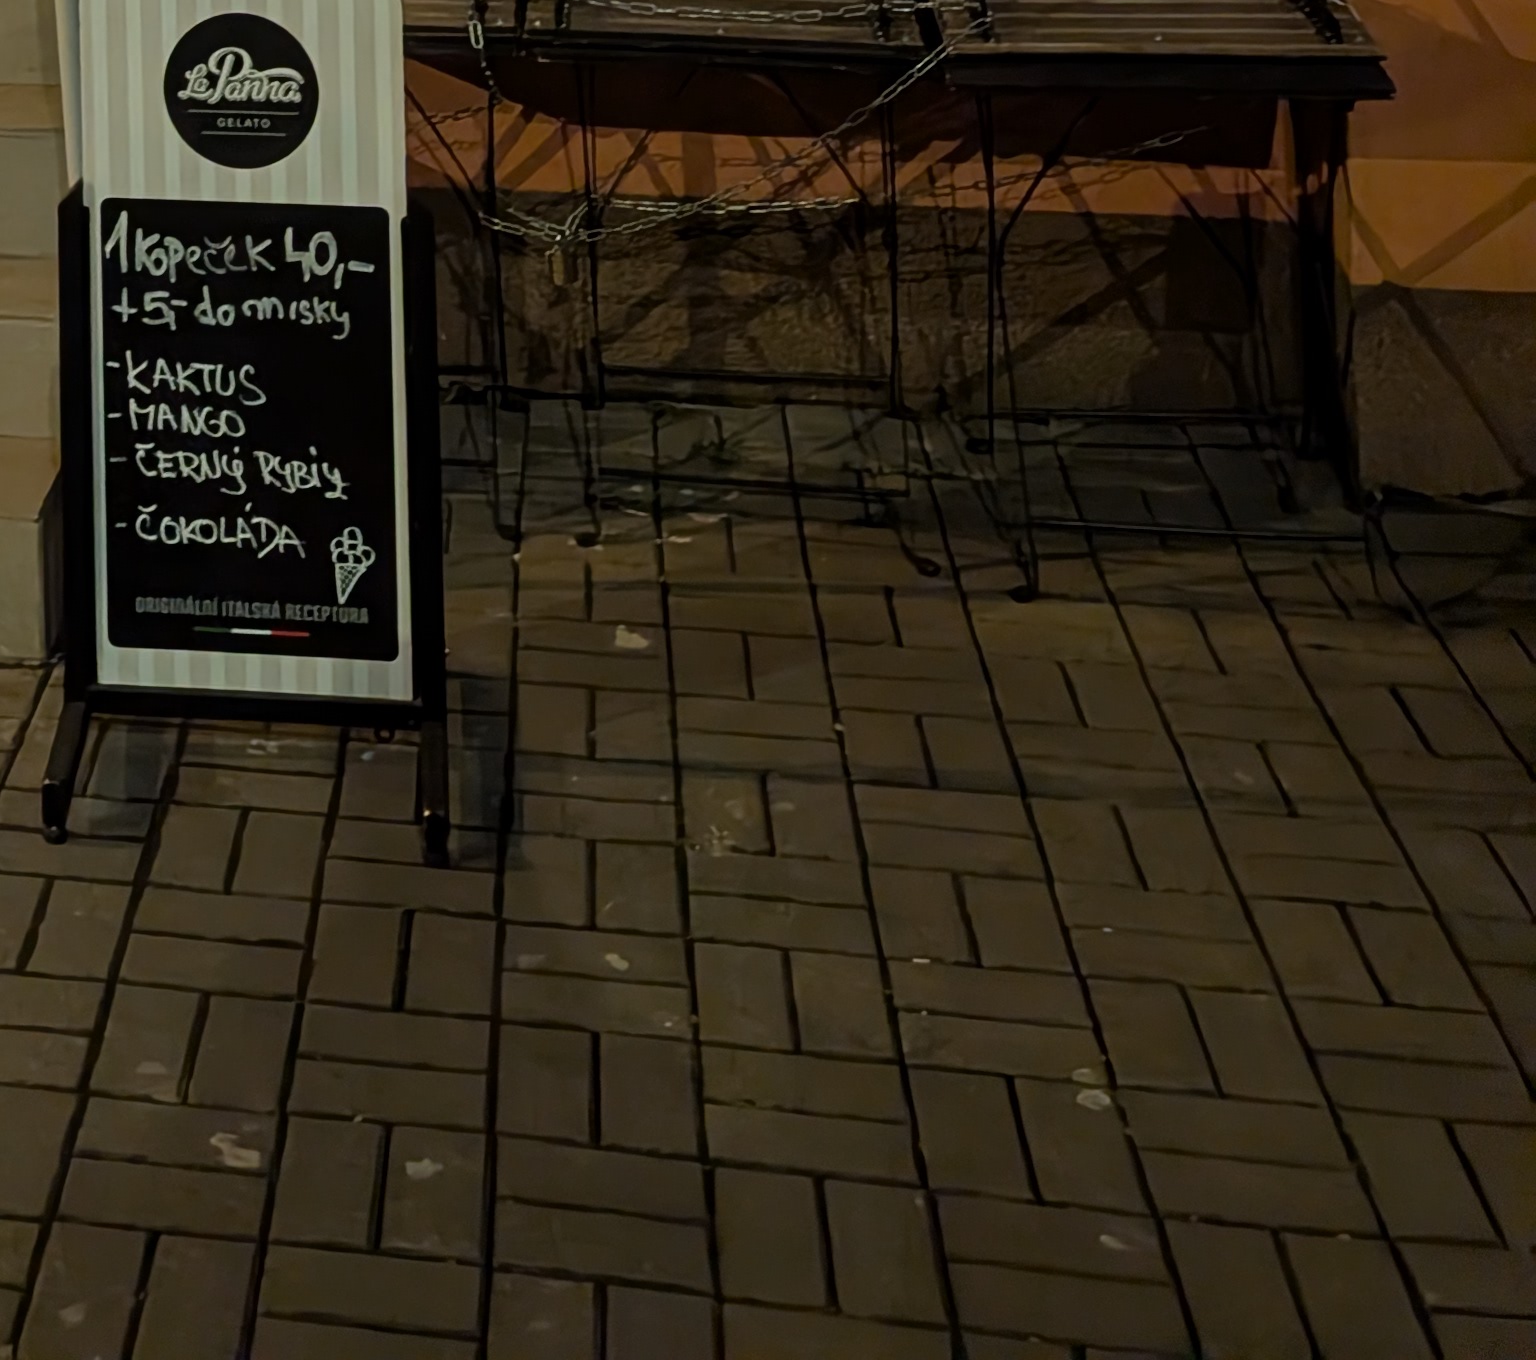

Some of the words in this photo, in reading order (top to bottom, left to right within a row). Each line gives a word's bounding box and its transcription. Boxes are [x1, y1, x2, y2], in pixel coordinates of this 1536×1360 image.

[177, 63, 214, 100] La
[207, 46, 306, 104] Panna
[216, 116, 271, 129] GELATO
[125, 349, 267, 406] KAKTUS
[129, 397, 247, 438] MANGO
[135, 501, 306, 559] ČOKOLÁDA
[222, 600, 281, 619] ITALSKÁ
[285, 603, 369, 624] RECEPTURA
